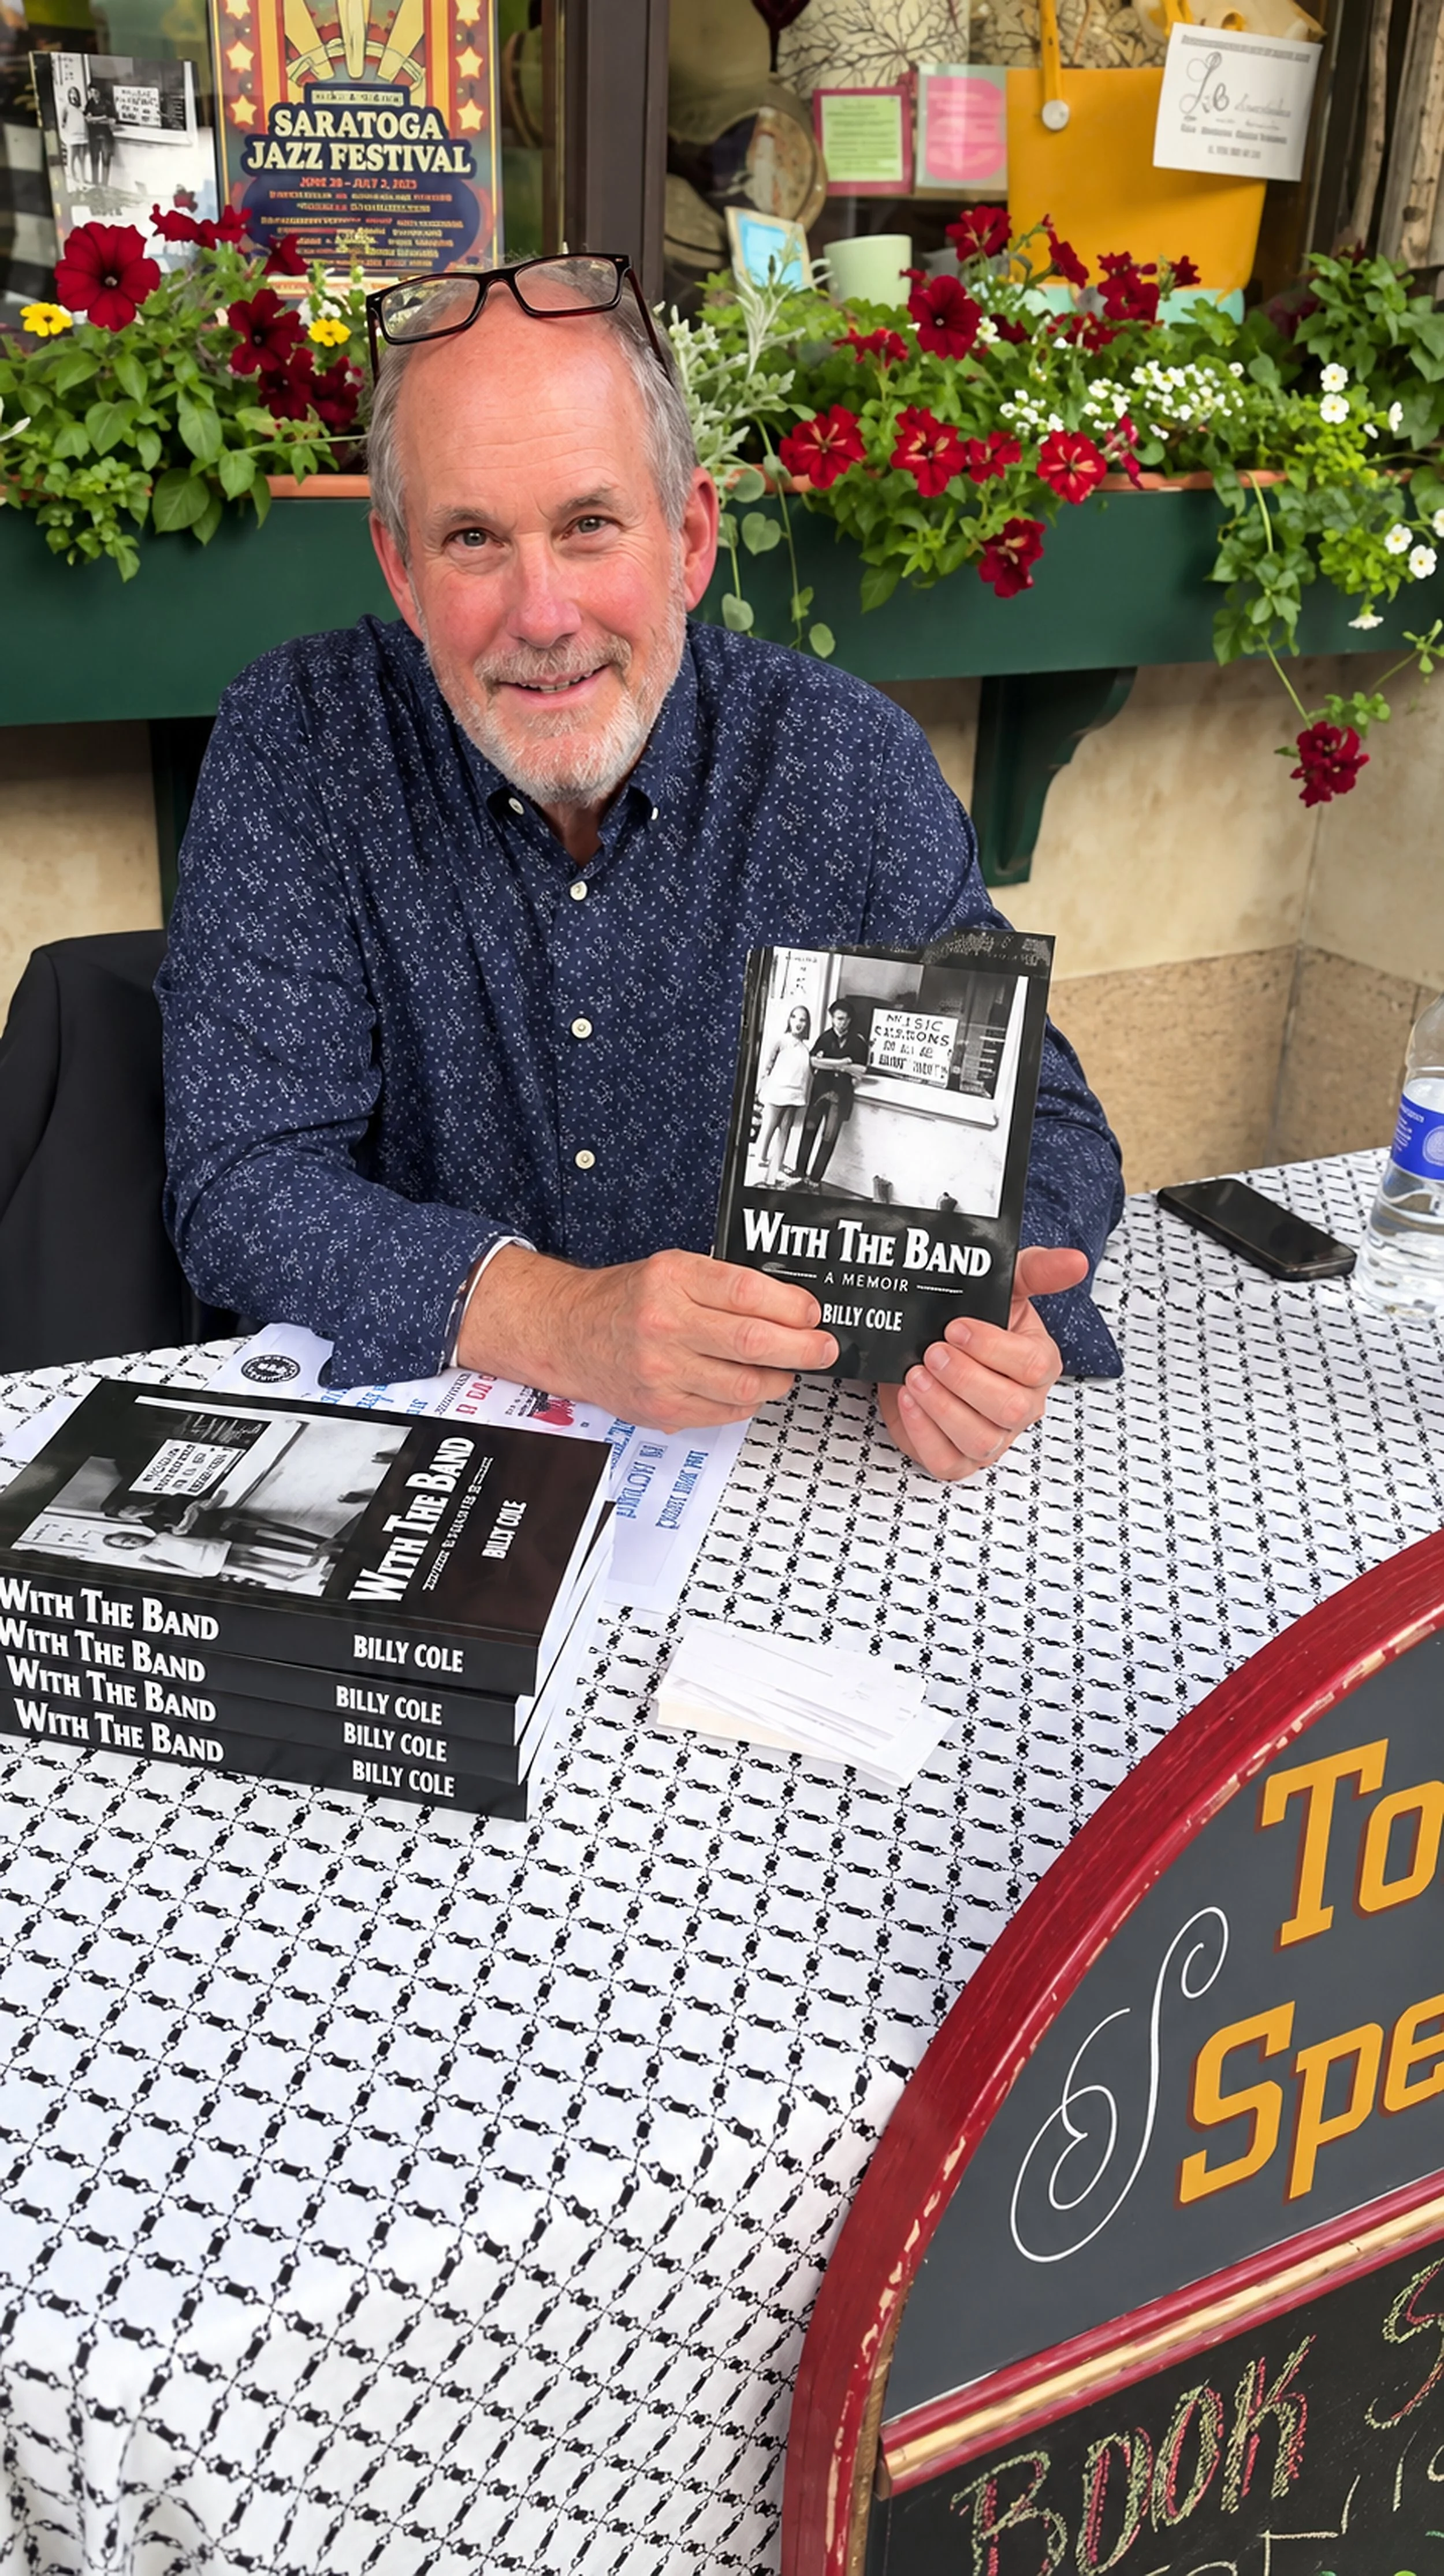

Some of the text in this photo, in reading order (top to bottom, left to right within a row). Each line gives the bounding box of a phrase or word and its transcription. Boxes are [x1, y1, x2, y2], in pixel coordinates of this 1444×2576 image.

[274, 109, 444, 140] SARATOGA
[247, 142, 472, 173] JAZZ FESTIVAL
[824, 1274, 910, 1293] A MEMOIR
[822, 1303, 903, 1331] BILLY COLE
[482, 1526, 516, 1559] BILLY
[353, 1634, 409, 1664] BILLY
[414, 1644, 464, 1673] COLE
[336, 1685, 389, 1715] BILLY
[395, 1696, 442, 1726] COLE
[344, 1722, 396, 1752] BILLY
[400, 1733, 447, 1762] COLE
[352, 1759, 403, 1788] BILLY
[408, 1770, 455, 1798] COLE
[1259, 1737, 1444, 1944] To
[950, 2335, 1316, 2576] BOOK
